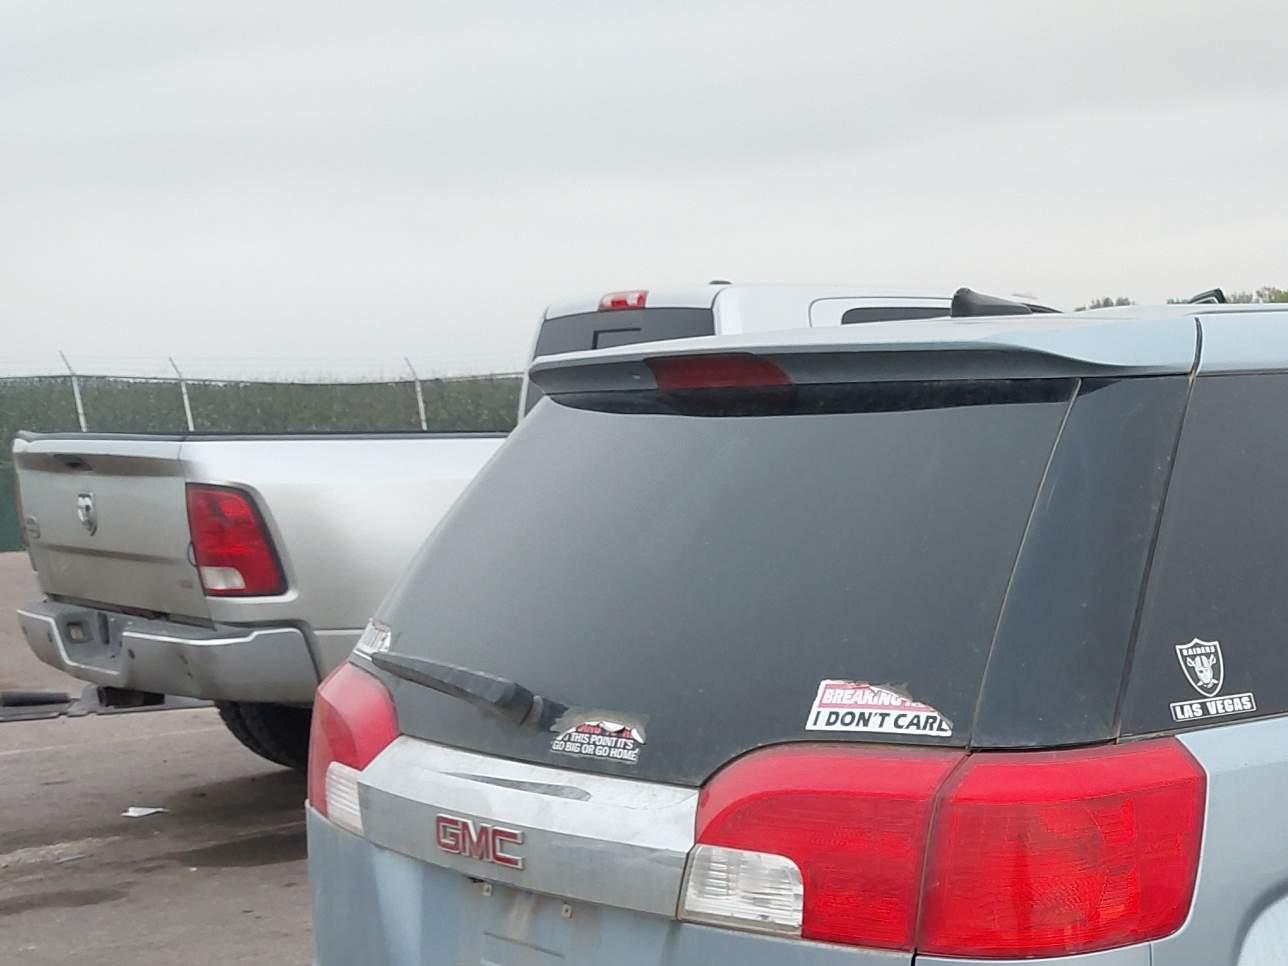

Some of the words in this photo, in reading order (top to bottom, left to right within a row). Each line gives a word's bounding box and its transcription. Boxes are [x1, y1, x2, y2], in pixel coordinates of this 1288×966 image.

[1182, 646, 1216, 656] RAIDERS
[1174, 703, 1203, 719] LAS
[1206, 696, 1253, 715] VEGAS
[812, 710, 822, 726] I
[825, 711, 891, 728] DON'T
[551, 740, 565, 751] GO
[565, 742, 581, 753] BIG
[581, 744, 595, 755] OR
[594, 746, 609, 757] GO
[609, 748, 639, 761] HOME
[570, 732, 590, 743] THIS
[590, 735, 617, 748] POINT
[616, 738, 634, 750] IT'S
[435, 813, 524, 870] GMC
